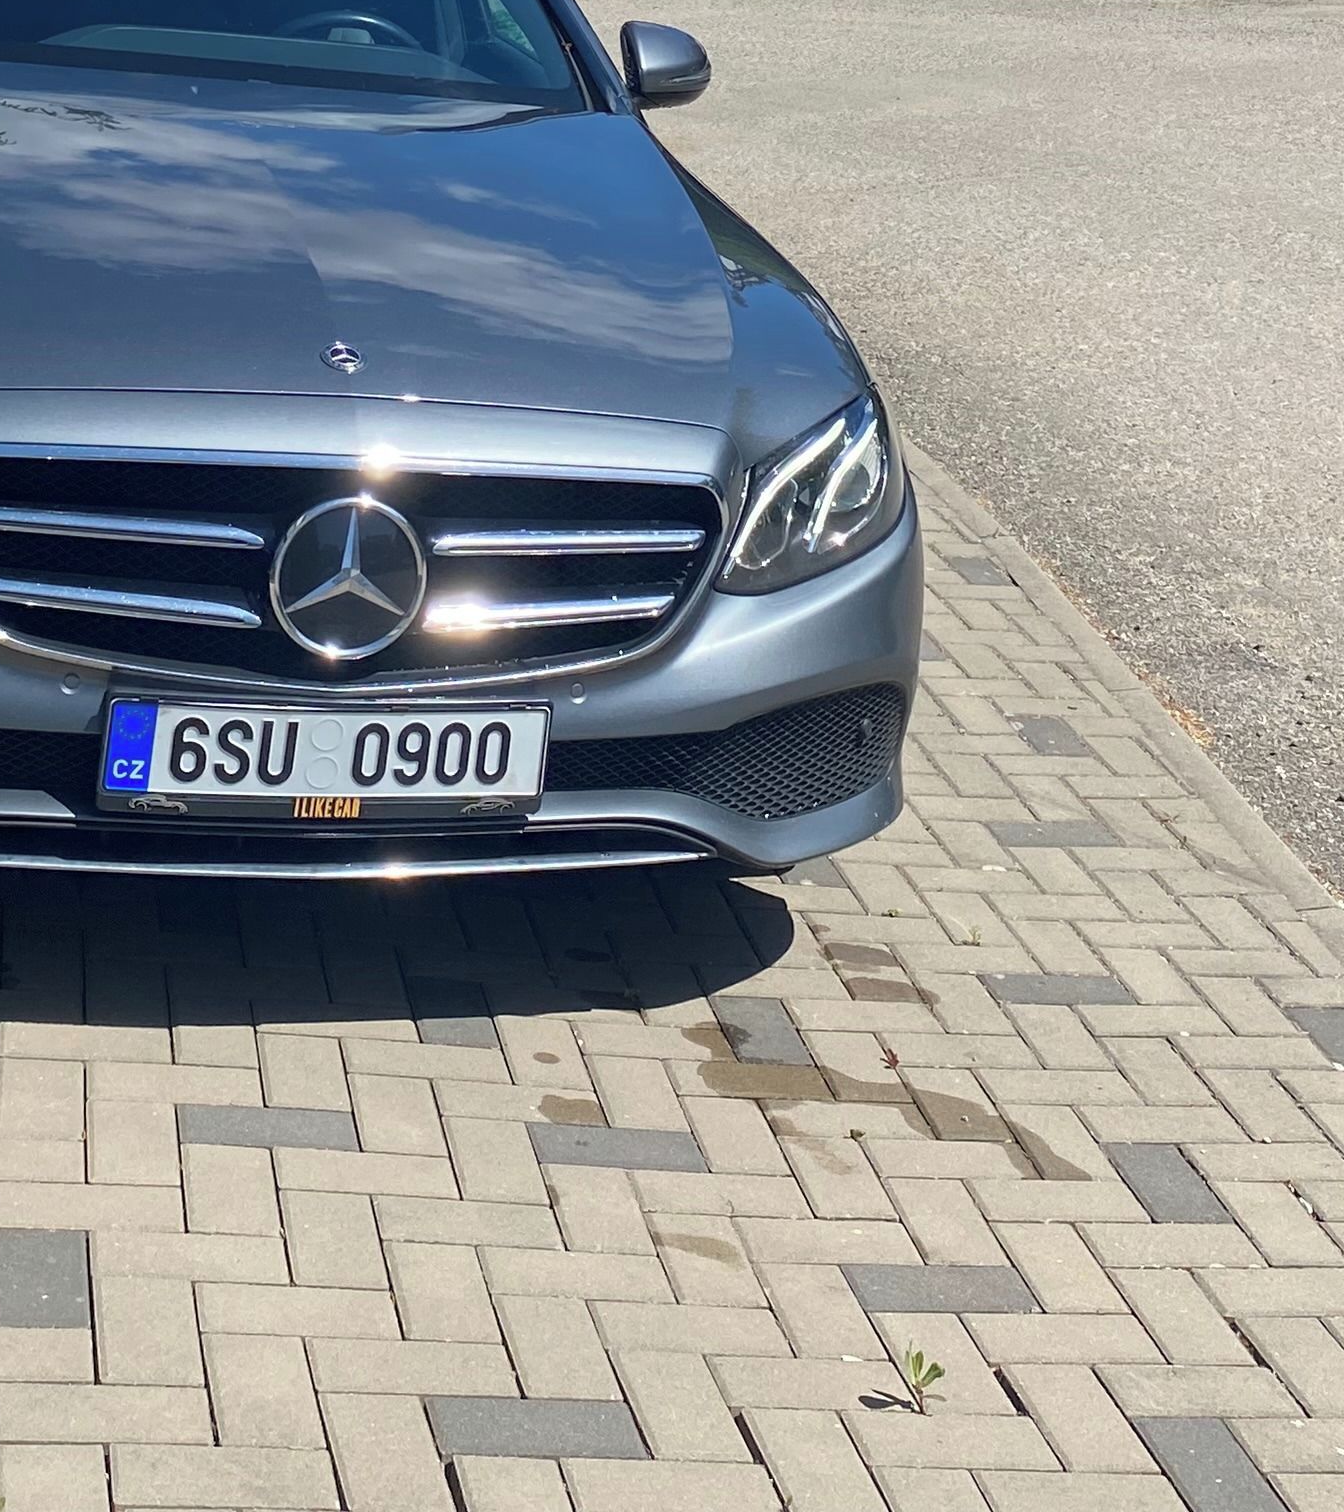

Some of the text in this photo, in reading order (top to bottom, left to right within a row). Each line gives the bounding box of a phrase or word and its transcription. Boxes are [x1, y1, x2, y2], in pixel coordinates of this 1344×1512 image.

[112, 759, 144, 781] CZ
[168, 716, 513, 787] 6SU 0900
